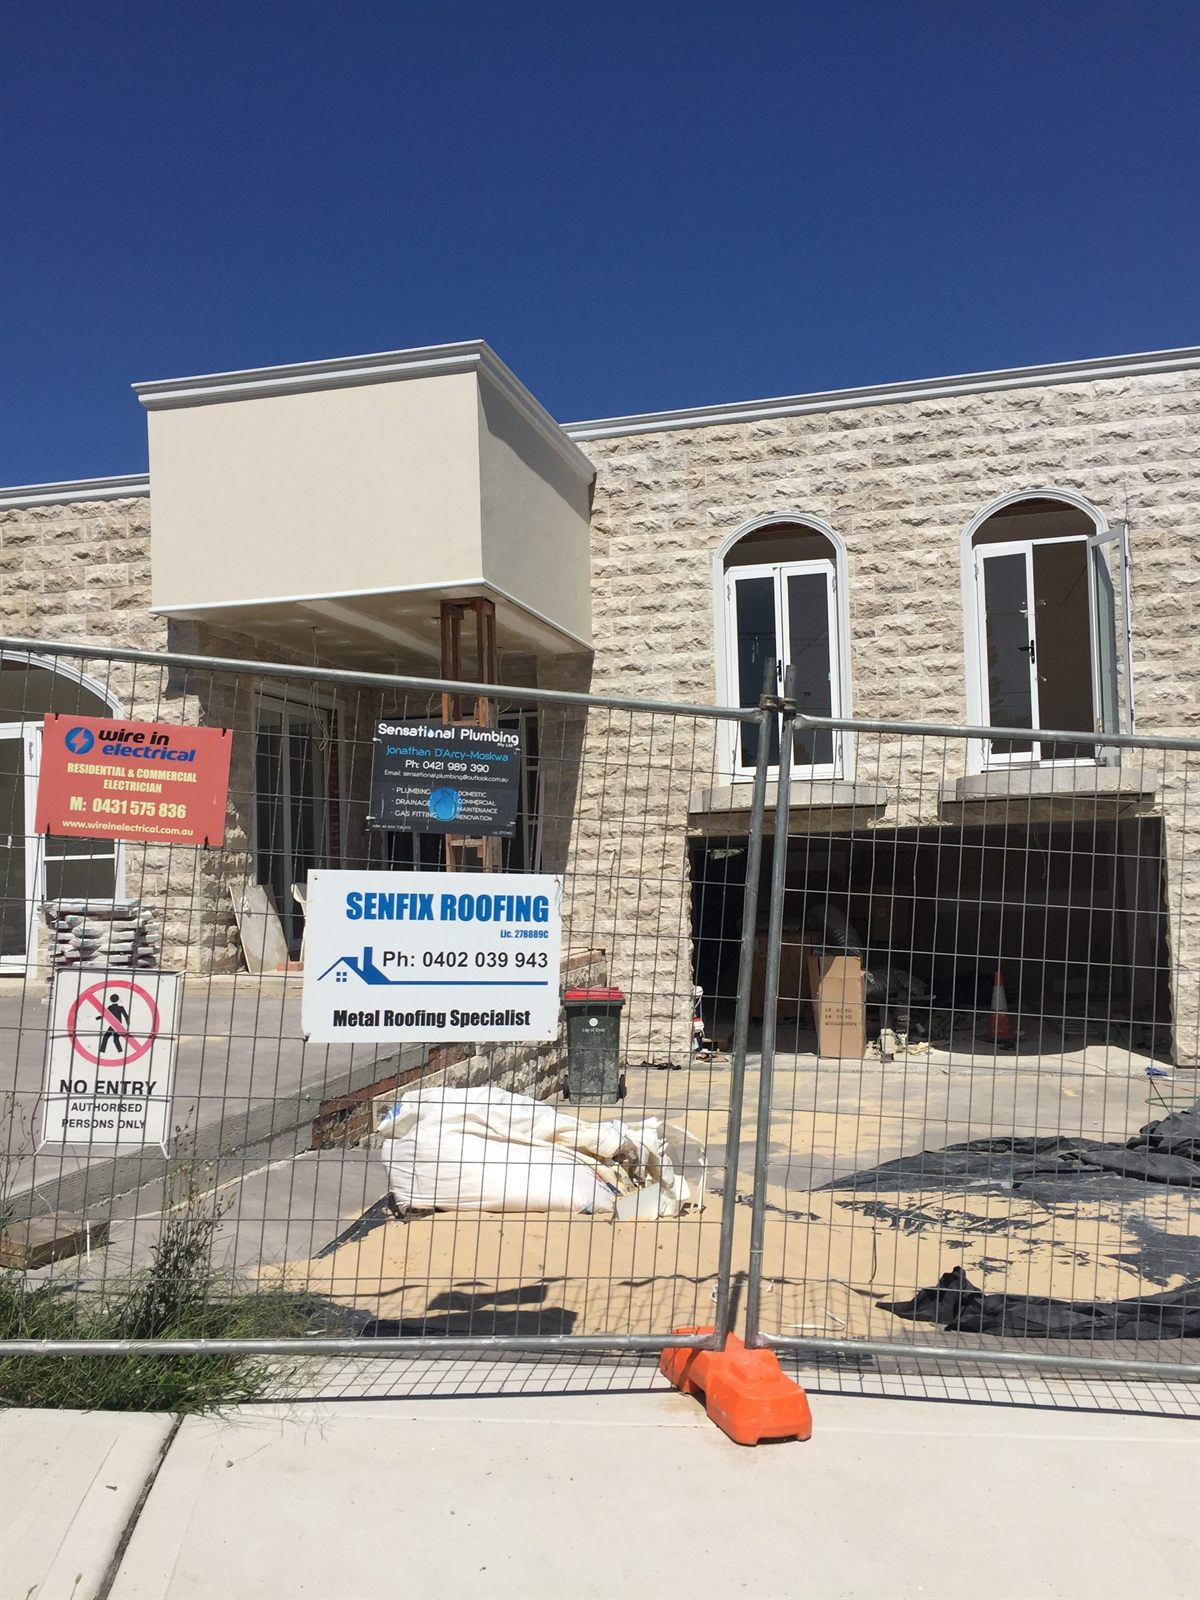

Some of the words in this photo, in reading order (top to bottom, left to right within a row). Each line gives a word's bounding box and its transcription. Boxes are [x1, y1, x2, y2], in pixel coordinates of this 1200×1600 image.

[98, 728, 145, 744] wire
[150, 731, 170, 746] in
[460, 728, 519, 745] Plumbing
[102, 743, 196, 762] electrical
[386, 745, 431, 757] Jonathan
[435, 748, 509, 762] D'Arcy-Moskwa
[67, 763, 126, 777] RESIDENTIAL
[128, 769, 135, 778] &
[136, 768, 197, 783] COMMERCIAL
[405, 759, 419, 769] Ph:
[422, 761, 444, 770] 0421
[447, 762, 467, 772] 989
[470, 763, 489, 773] 390
[103, 779, 162, 793] ELECTRICIAN
[396, 787, 431, 795] PLUMBING
[457, 790, 487, 798] DOMESTIC
[69, 796, 87, 812] M:
[92, 797, 128, 815] 0431
[130, 801, 156, 817] 575
[158, 803, 187, 819] 836
[395, 798, 431, 807] DRAINAGE
[457, 798, 496, 807] COMMERCIAL
[411, 810, 437, 819] FITTING
[456, 806, 498, 814] MAINTENANCE
[456, 814, 493, 822] RENOVATION
[62, 820, 194, 836] www.wireinelectrical.com.au
[346, 892, 435, 921] SENFIX
[440, 894, 549, 923] ROOFING
[500, 929, 513, 939] Lic.
[514, 930, 549, 939] 278889C
[382, 951, 415, 967] Ph:
[422, 951, 469, 968] 0402
[475, 951, 509, 968] 039
[515, 952, 548, 968] 943
[333, 1010, 380, 1027] Metal
[384, 1010, 446, 1028] Roofing
[450, 1009, 530, 1028] Specialist
[60, 1079, 88, 1094] NO
[95, 1080, 157, 1095] ENTRY
[71, 1102, 142, 1113] AUTHORISED
[61, 1118, 114, 1129] PERSONS
[118, 1119, 145, 1129] ONLY
